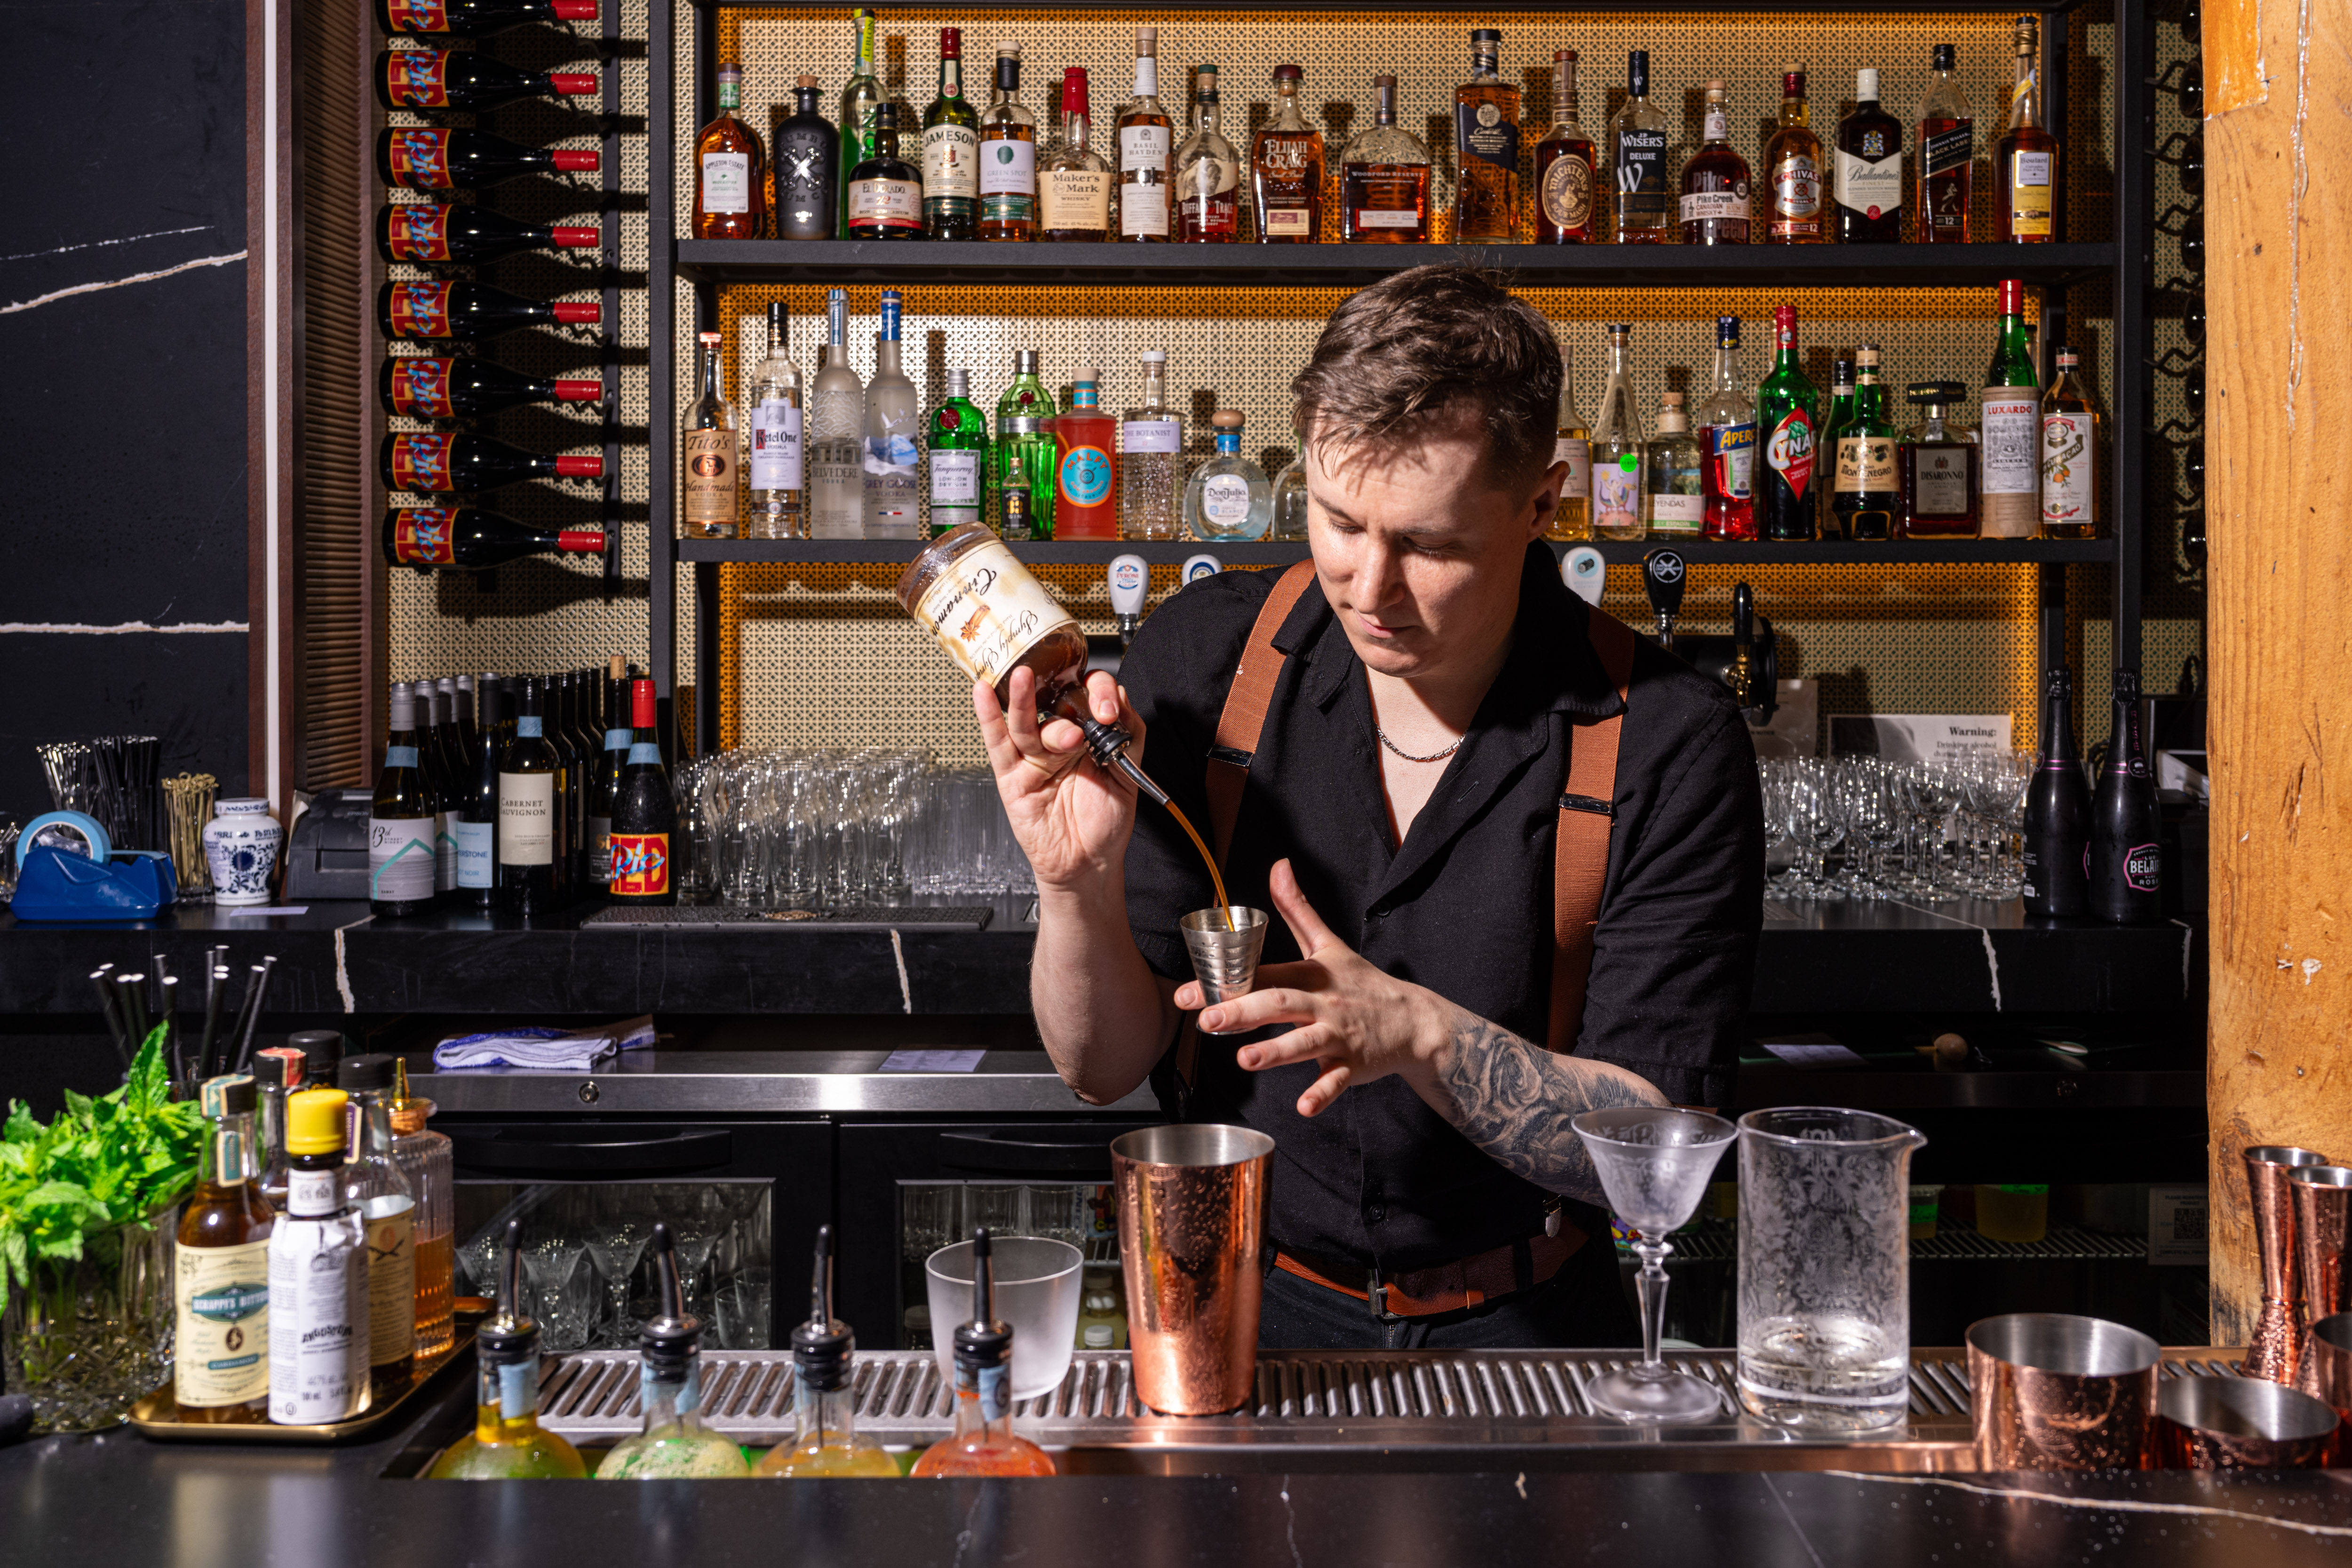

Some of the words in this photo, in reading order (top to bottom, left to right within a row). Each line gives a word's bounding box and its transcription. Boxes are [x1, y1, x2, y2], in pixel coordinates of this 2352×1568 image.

[864, 20, 874, 57] LEBLON
[925, 131, 975, 147] JAMESON
[1621, 135, 1665, 147] WISER'S
[1266, 139, 1307, 155] ELIJAH
[1629, 152, 1656, 160] DELUXE
[1926, 147, 1949, 160] BLACK
[706, 160, 727, 170] APPLETON
[728, 160, 745, 170] ESTATE
[1266, 153, 1308, 169] CRAIG
[1549, 164, 1589, 191] MICHTER'S
[1781, 170, 1819, 181] CHIVAS
[1847, 165, 1901, 182] Ballantine's
[863, 183, 871, 192] EL
[873, 183, 906, 194] DORADO
[876, 196, 891, 206] 12
[1697, 195, 1711, 204] Pike
[1182, 202, 1208, 215] BUFFAO
[1214, 200, 1233, 214] TRACE
[1945, 216, 1954, 225] 12
[1810, 223, 1818, 232] 12
[1988, 405, 2032, 414] LUXARDO
[689, 435, 730, 450] Tito's
[756, 430, 779, 449] Ketel
[780, 431, 797, 443] One
[1067, 452, 1108, 470] MALFY
[812, 467, 859, 478] BELVEDERE
[934, 463, 974, 475] Tanqueray
[1921, 470, 1964, 480] DISARONNO
[686, 480, 734, 493] Handmade
[865, 479, 884, 489] GREY
[886, 478, 916, 489] GOOSE
[1208, 487, 1225, 497] Don
[1224, 487, 1247, 500] Julio
[932, 568, 997, 637] Cinnamon
[999, 610, 1039, 660] Symply
[1949, 726, 1997, 738] Warning:
[1937, 740, 1967, 750] Drinking
[1969, 740, 1997, 749] alcohol
[501, 797, 544, 807] CABERNET
[500, 806, 547, 816] SAUVIGNON
[611, 842, 666, 880] Rio
[193, 1297, 236, 1311] SCRAPPY'S
